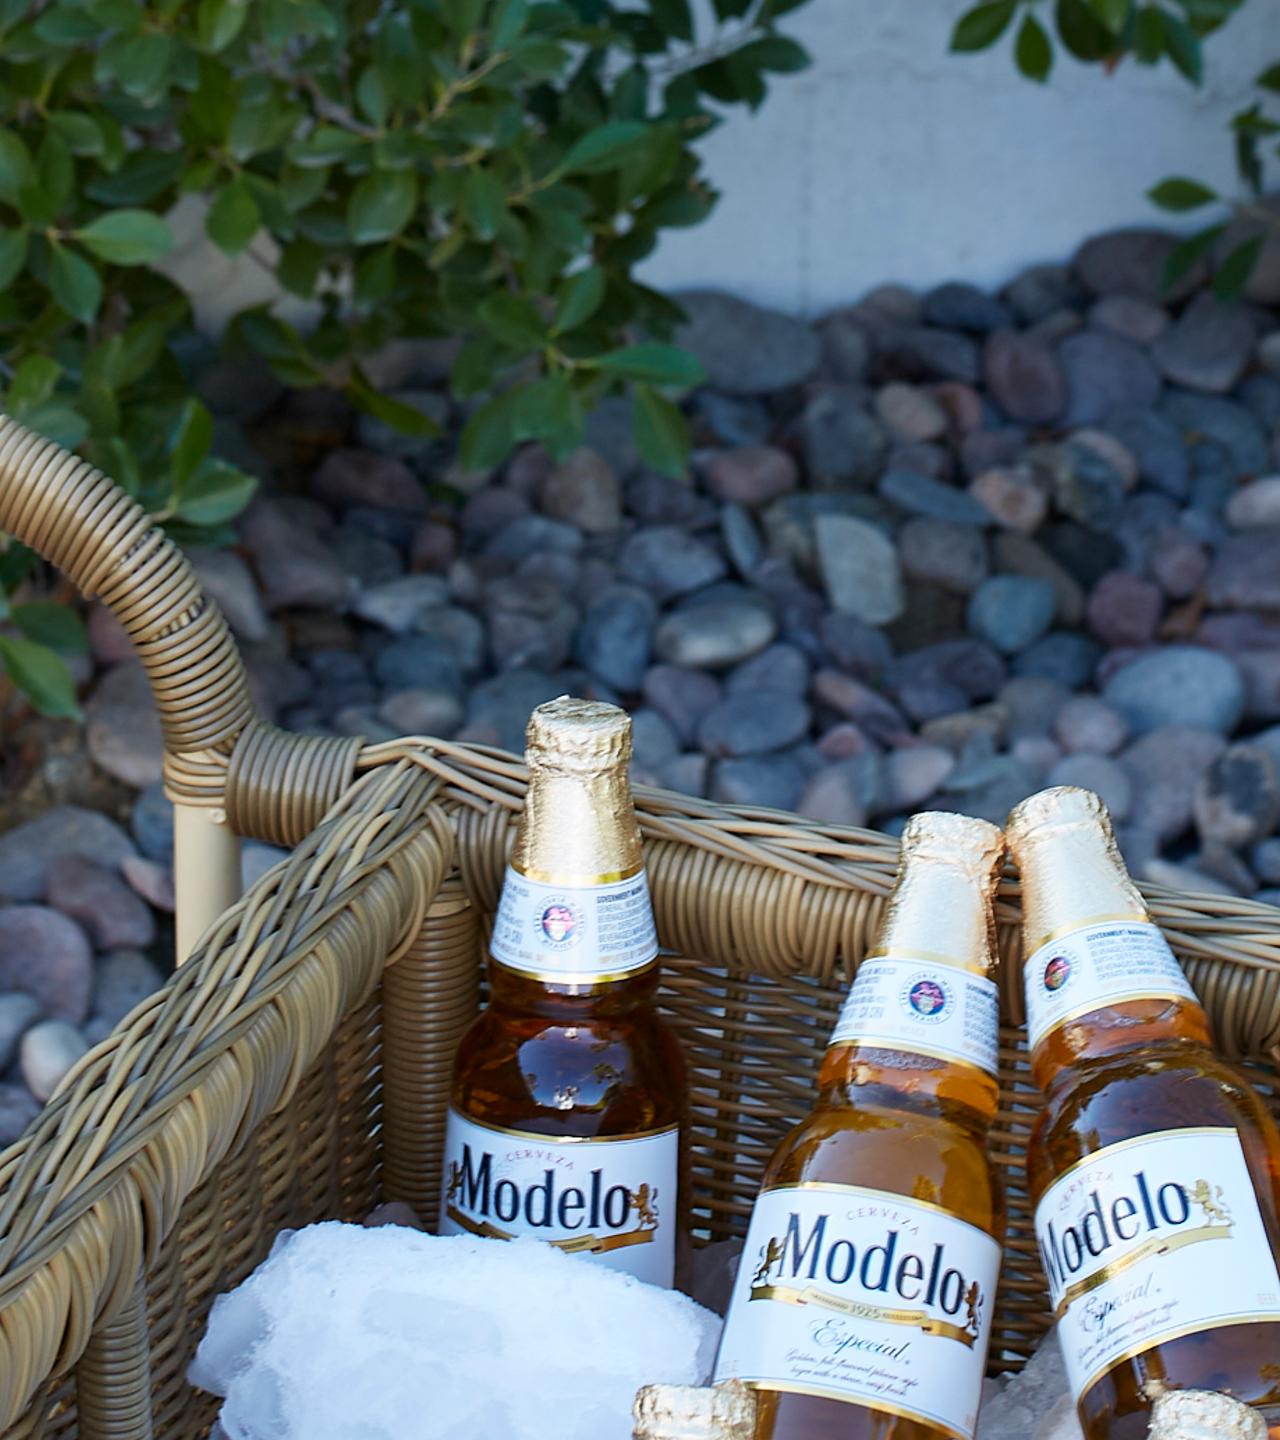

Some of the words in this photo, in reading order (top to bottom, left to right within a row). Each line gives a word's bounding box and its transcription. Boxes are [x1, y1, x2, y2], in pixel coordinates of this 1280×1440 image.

[459, 1142, 631, 1230] Modelo
[505, 1149, 575, 1170] CERVEZA
[847, 1208, 919, 1236] CERVEZA
[1040, 1170, 1191, 1293] Modelo
[777, 1212, 965, 1315] Modelo
[809, 1318, 912, 1365] Especial
